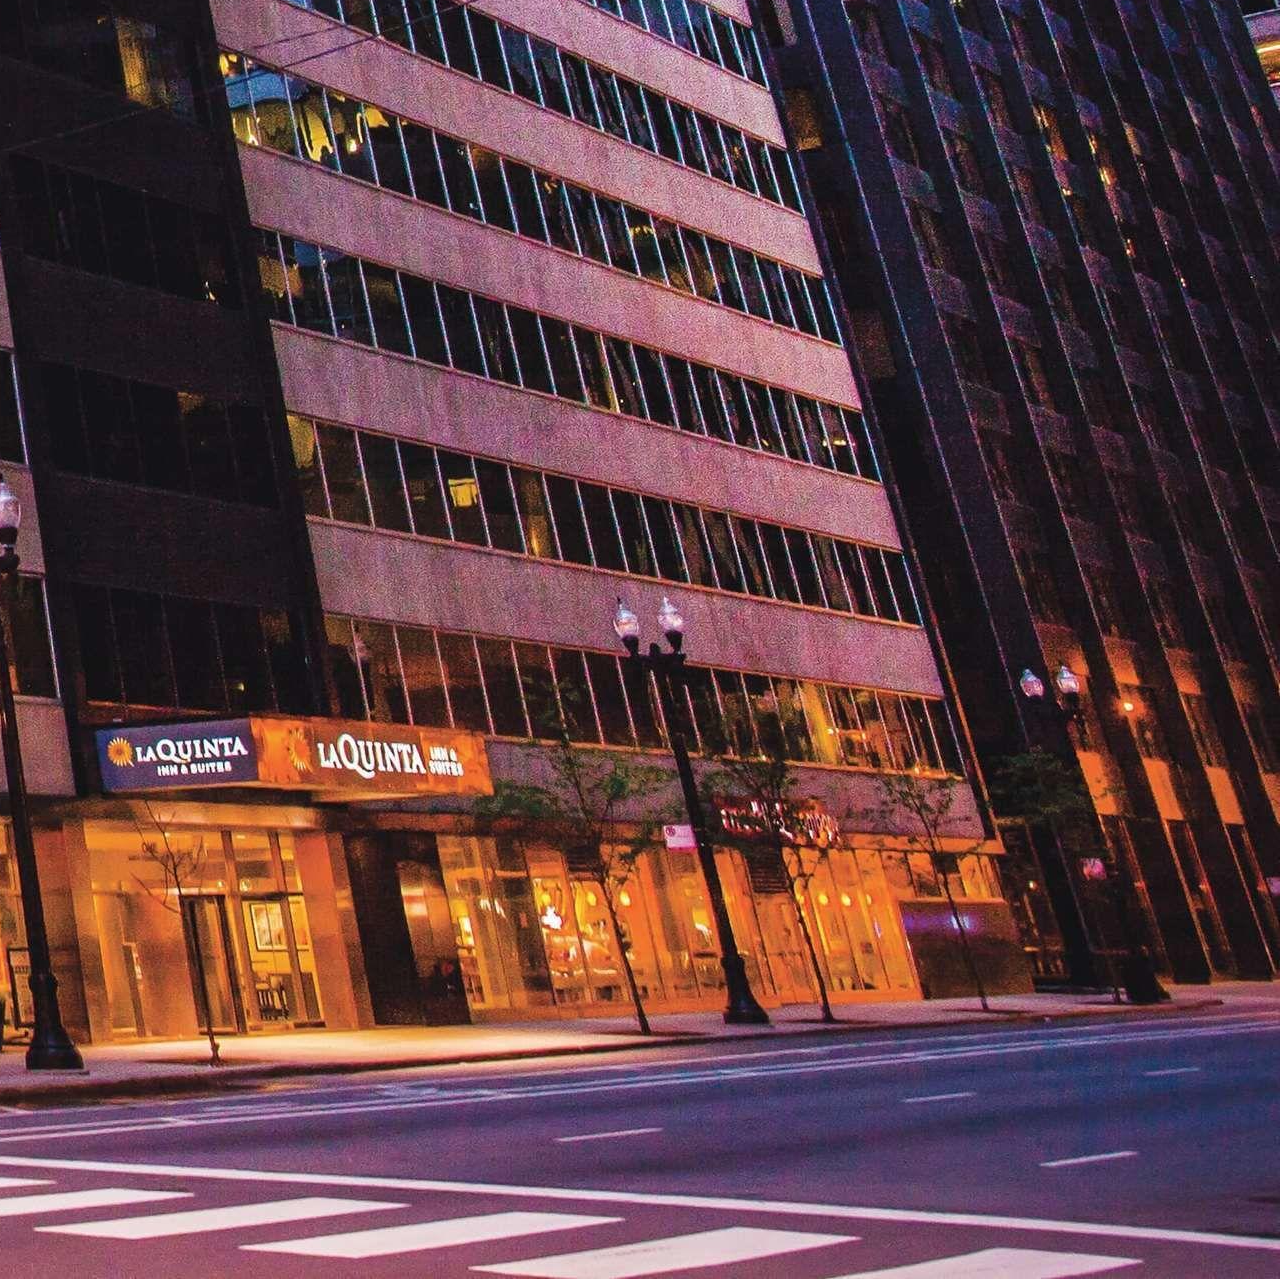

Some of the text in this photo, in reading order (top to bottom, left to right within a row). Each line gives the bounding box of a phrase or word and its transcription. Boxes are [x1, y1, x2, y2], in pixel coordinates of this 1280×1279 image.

[135, 736, 248, 764] LA QUINTA
[317, 742, 343, 769] LA
[338, 733, 427, 779] QUINTA
[157, 765, 178, 776] INN
[191, 761, 232, 774] SUITES
